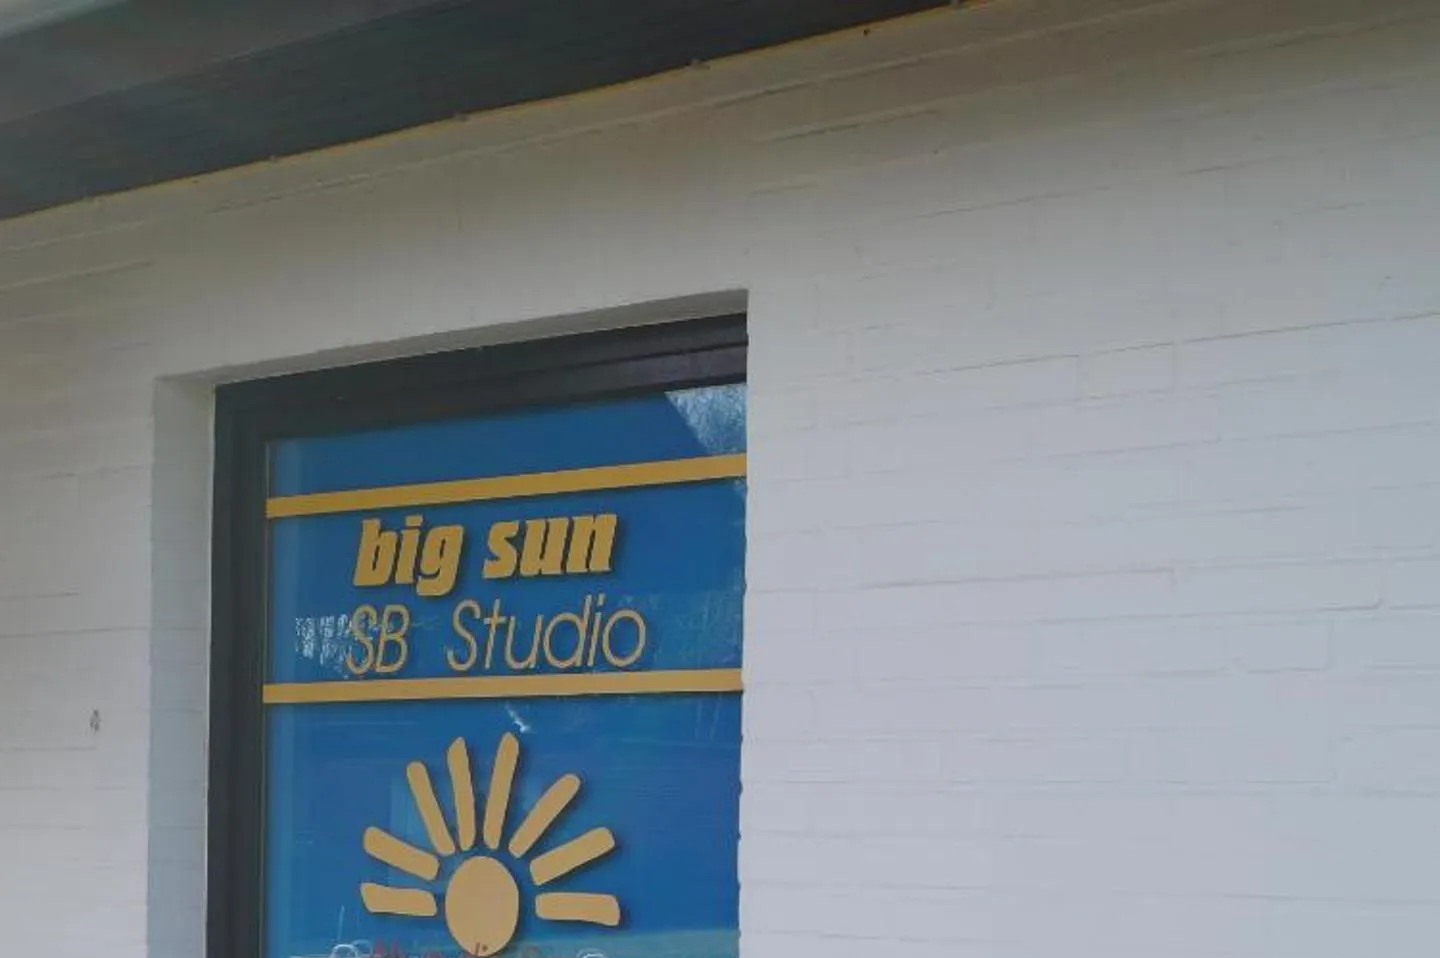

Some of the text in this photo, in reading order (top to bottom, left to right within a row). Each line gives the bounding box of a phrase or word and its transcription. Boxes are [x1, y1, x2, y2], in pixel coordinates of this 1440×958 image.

[353, 513, 618, 596] big sun
[344, 593, 648, 676] SB Studio
